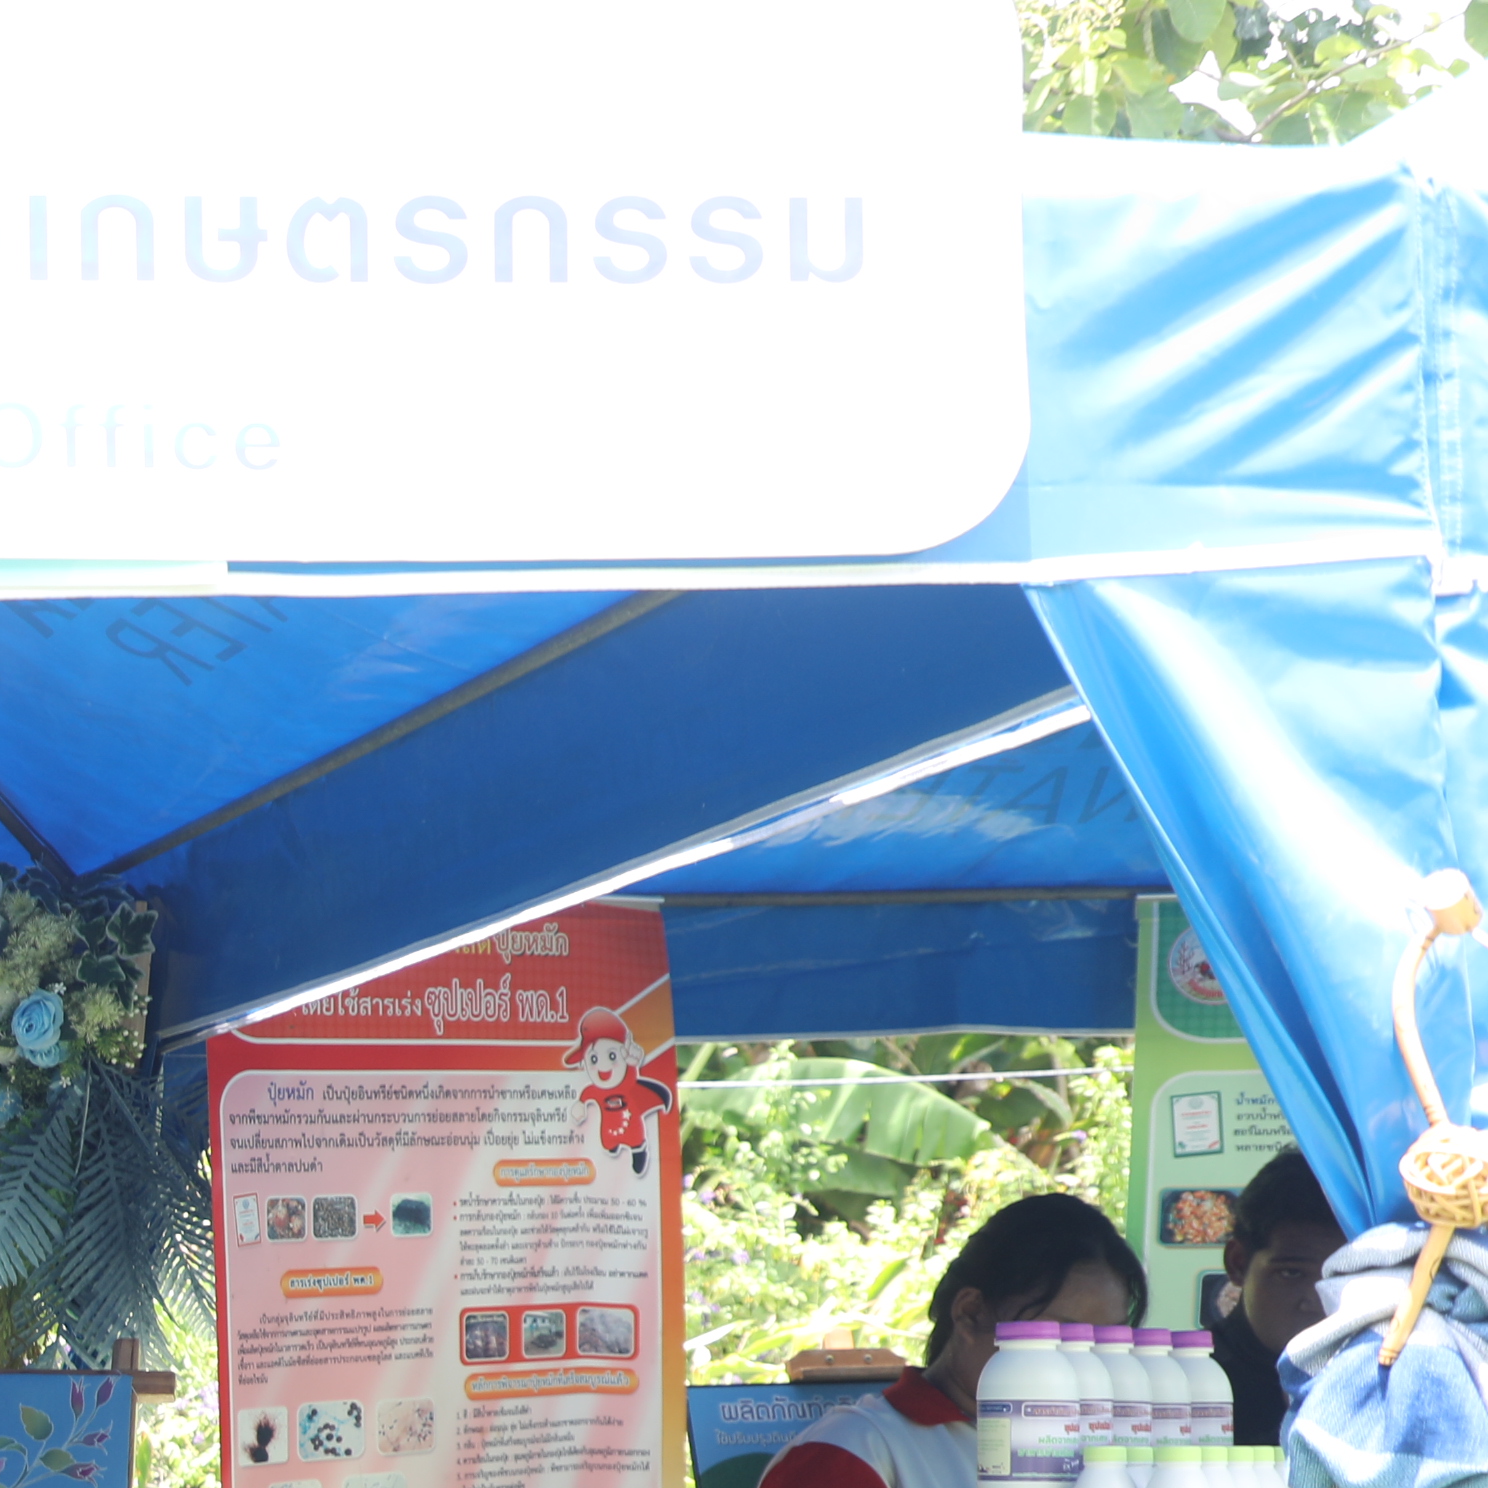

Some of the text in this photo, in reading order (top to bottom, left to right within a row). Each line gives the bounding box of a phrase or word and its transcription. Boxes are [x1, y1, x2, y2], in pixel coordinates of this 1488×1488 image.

[425, 973, 569, 1035] ซุปเปอร์ พด.1
[267, 1081, 314, 1106] ปุ๋ยหมัก
